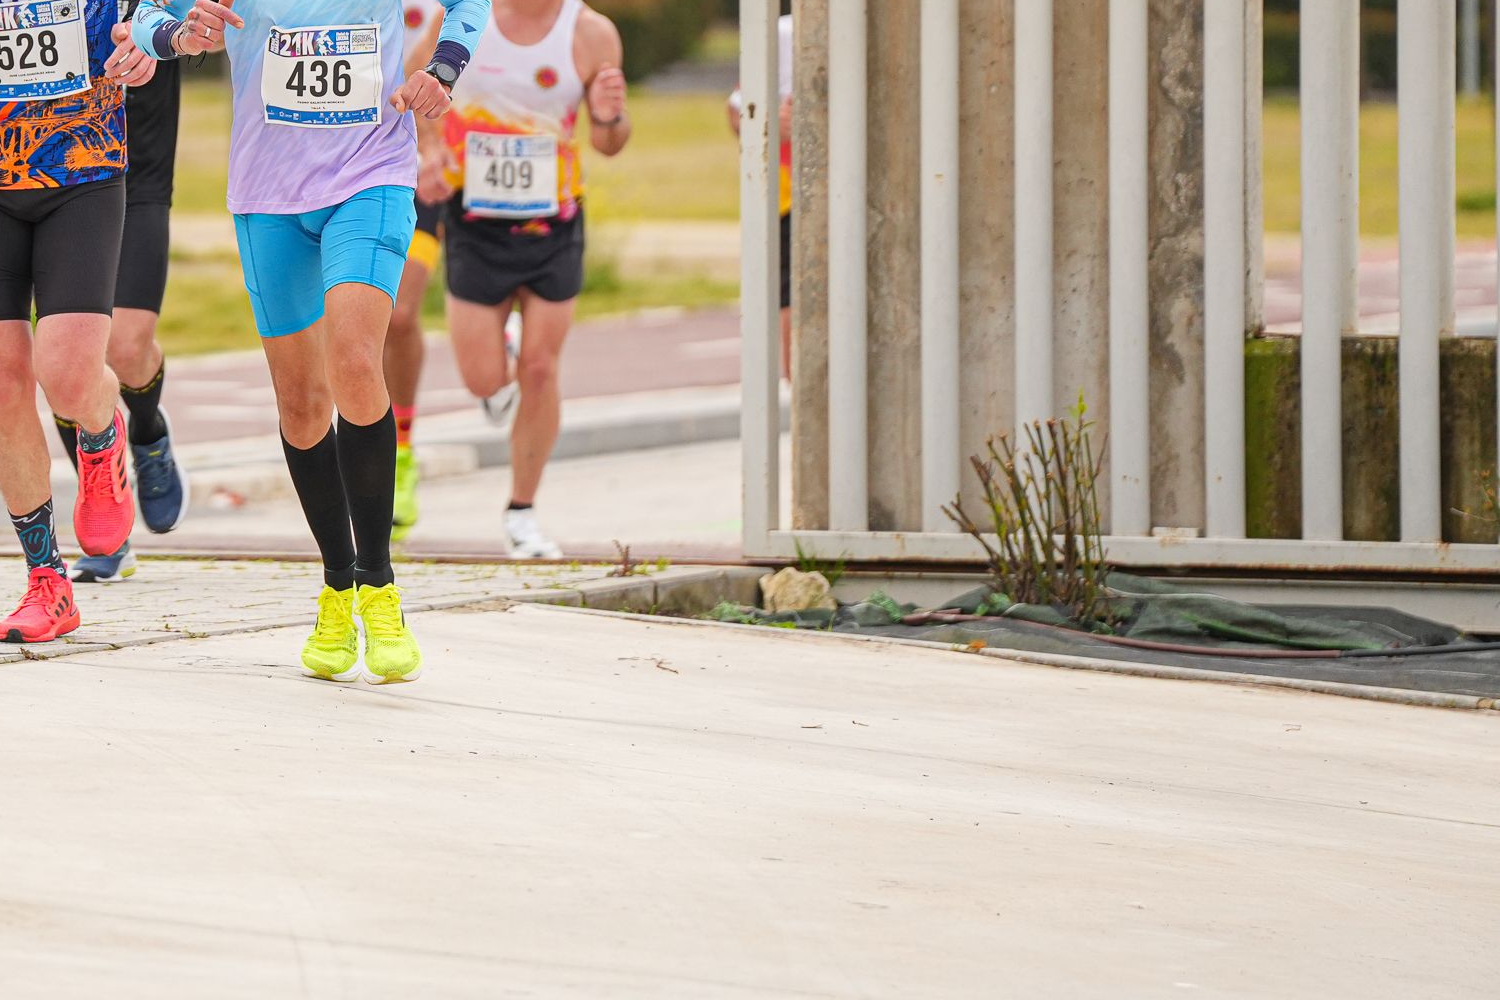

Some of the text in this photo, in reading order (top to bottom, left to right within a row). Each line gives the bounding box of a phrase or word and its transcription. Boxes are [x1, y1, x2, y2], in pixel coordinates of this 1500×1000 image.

[279, 31, 315, 57] 21K
[285, 59, 352, 98] 436
[484, 159, 533, 189] 409
